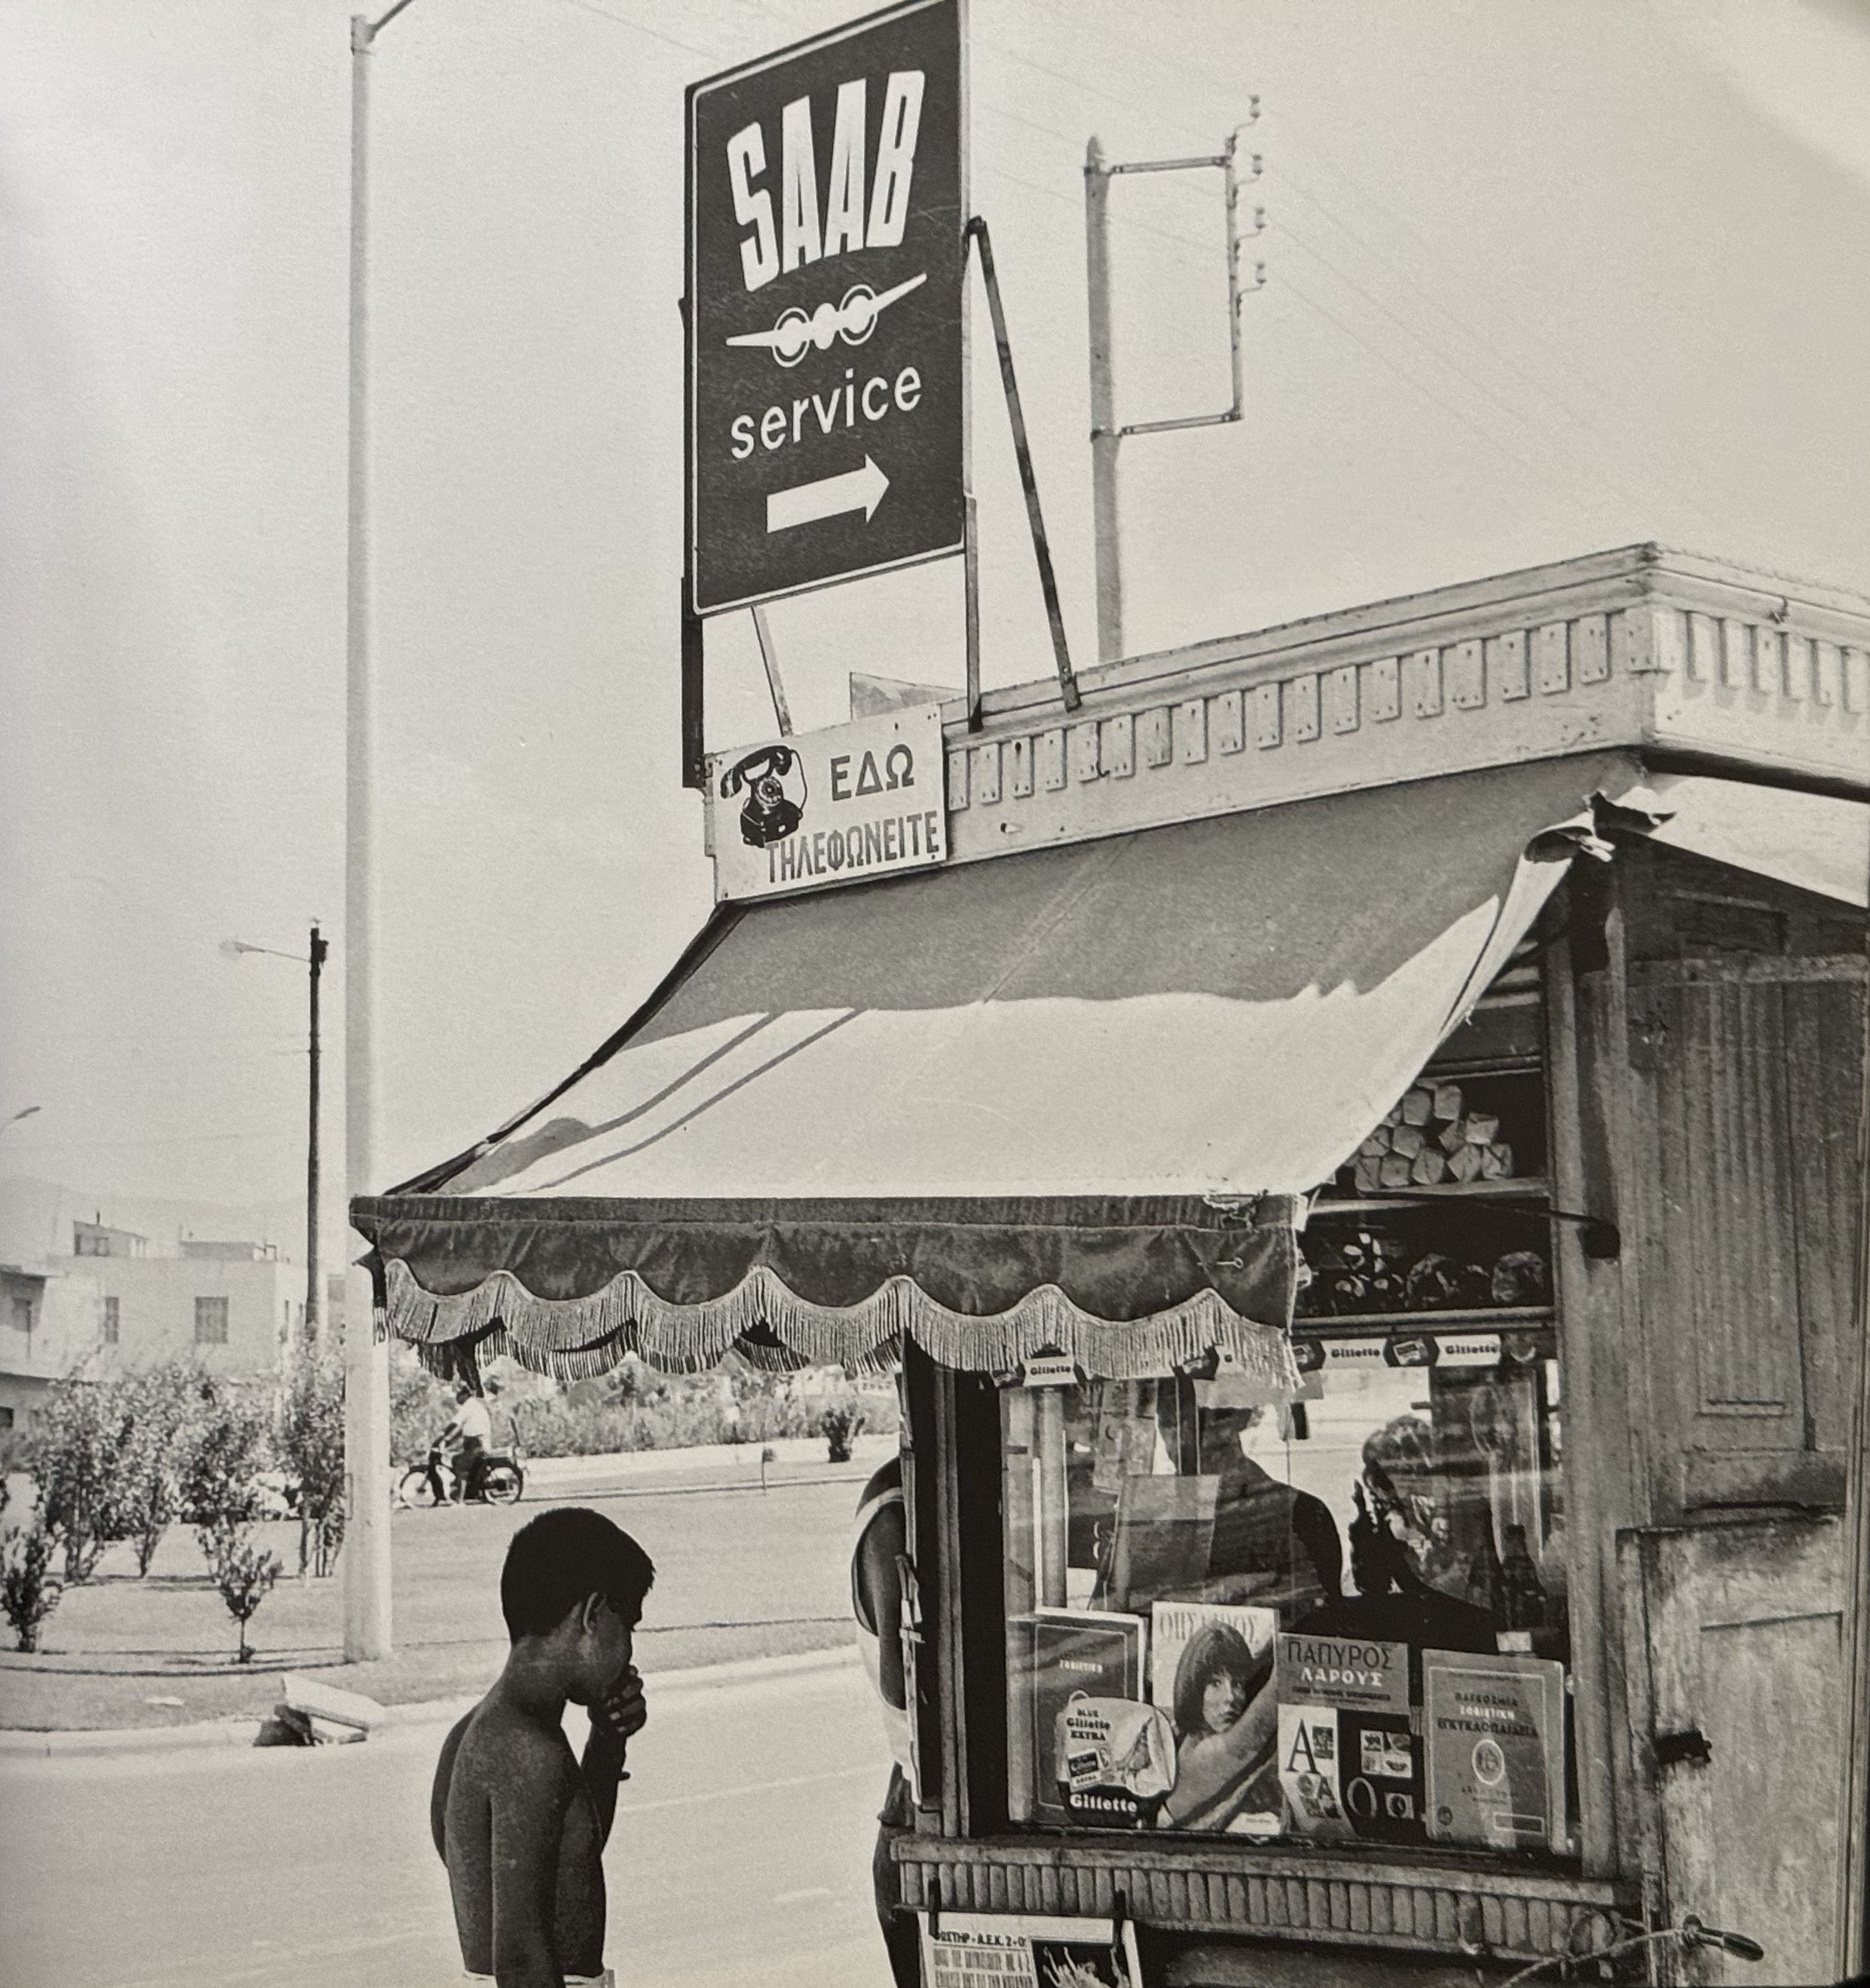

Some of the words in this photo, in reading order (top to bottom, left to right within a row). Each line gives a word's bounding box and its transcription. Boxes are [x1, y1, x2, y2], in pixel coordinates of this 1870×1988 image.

[726, 70, 925, 292] SAAB
[730, 366, 922, 459] service
[830, 743, 914, 802] ΕΔΩ
[765, 810, 939, 883] ΤΗΛΕΦΩΝΕΙΤΕ
[1330, 1347, 1380, 1358] Gillette
[1445, 1344, 1498, 1355] Gillette
[1030, 1365, 1071, 1376] Gillette
[1288, 1641, 1392, 1671] ΠΑΠΥΡΟΣ
[1301, 1667, 1383, 1687] ΛΑΡΟΥΣ
[1066, 1717, 1111, 1730] Gillette
[1069, 1793, 1138, 1813] Gillette
